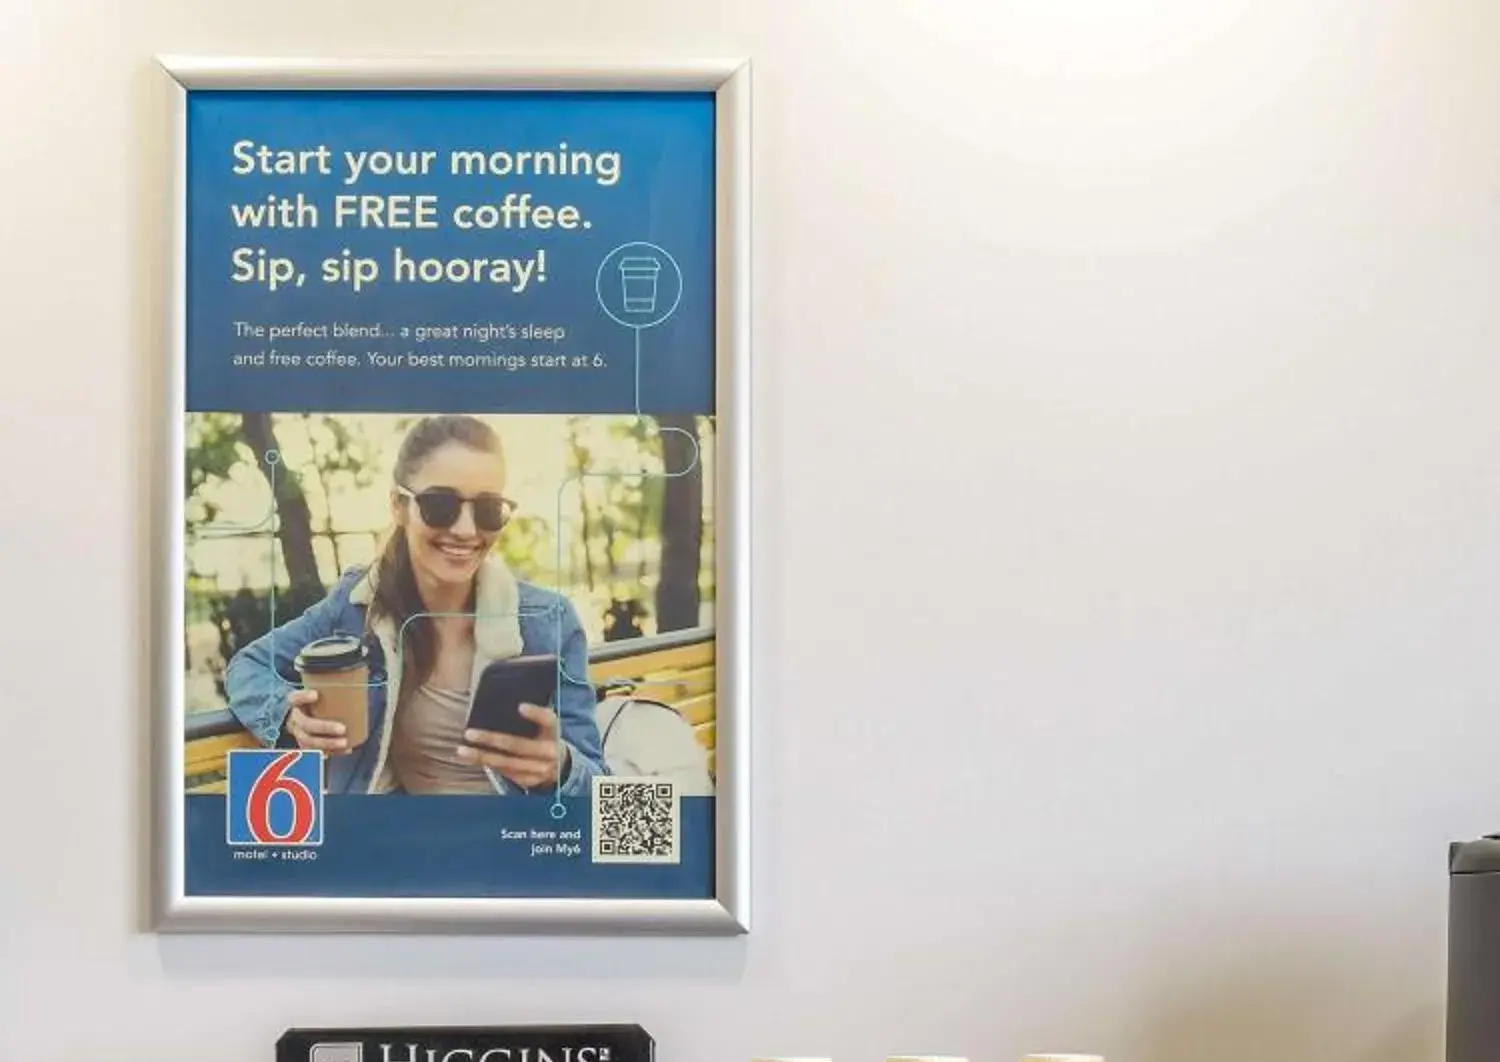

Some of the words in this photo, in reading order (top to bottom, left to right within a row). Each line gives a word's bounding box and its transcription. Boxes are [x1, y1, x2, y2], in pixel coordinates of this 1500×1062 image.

[232, 139, 332, 177] Start
[345, 147, 437, 185] your
[450, 143, 622, 186] morning
[232, 194, 319, 229] with
[335, 196, 439, 229] FREE
[453, 195, 593, 230] coffee.
[232, 248, 306, 290] Sip,
[321, 250, 379, 291] sip
[393, 249, 548, 292] hooray!
[233, 321, 265, 337] The
[269, 321, 329, 343] perfect
[399, 326, 410, 339] a
[415, 324, 459, 343] great
[462, 323, 516, 342] night's
[521, 323, 566, 344] sleep
[233, 351, 265, 366] and
[269, 349, 302, 366] free
[305, 350, 361, 367] coffee.
[367, 351, 404, 366] Your
[407, 351, 445, 367] best
[449, 351, 527, 371] mornings
[530, 353, 567, 368] start
[571, 353, 588, 368] at
[245, 749, 316, 845] 6
[501, 829, 527, 839] Scan
[559, 828, 581, 839] and
[281, 849, 318, 860] studio
[530, 843, 553, 857] join
